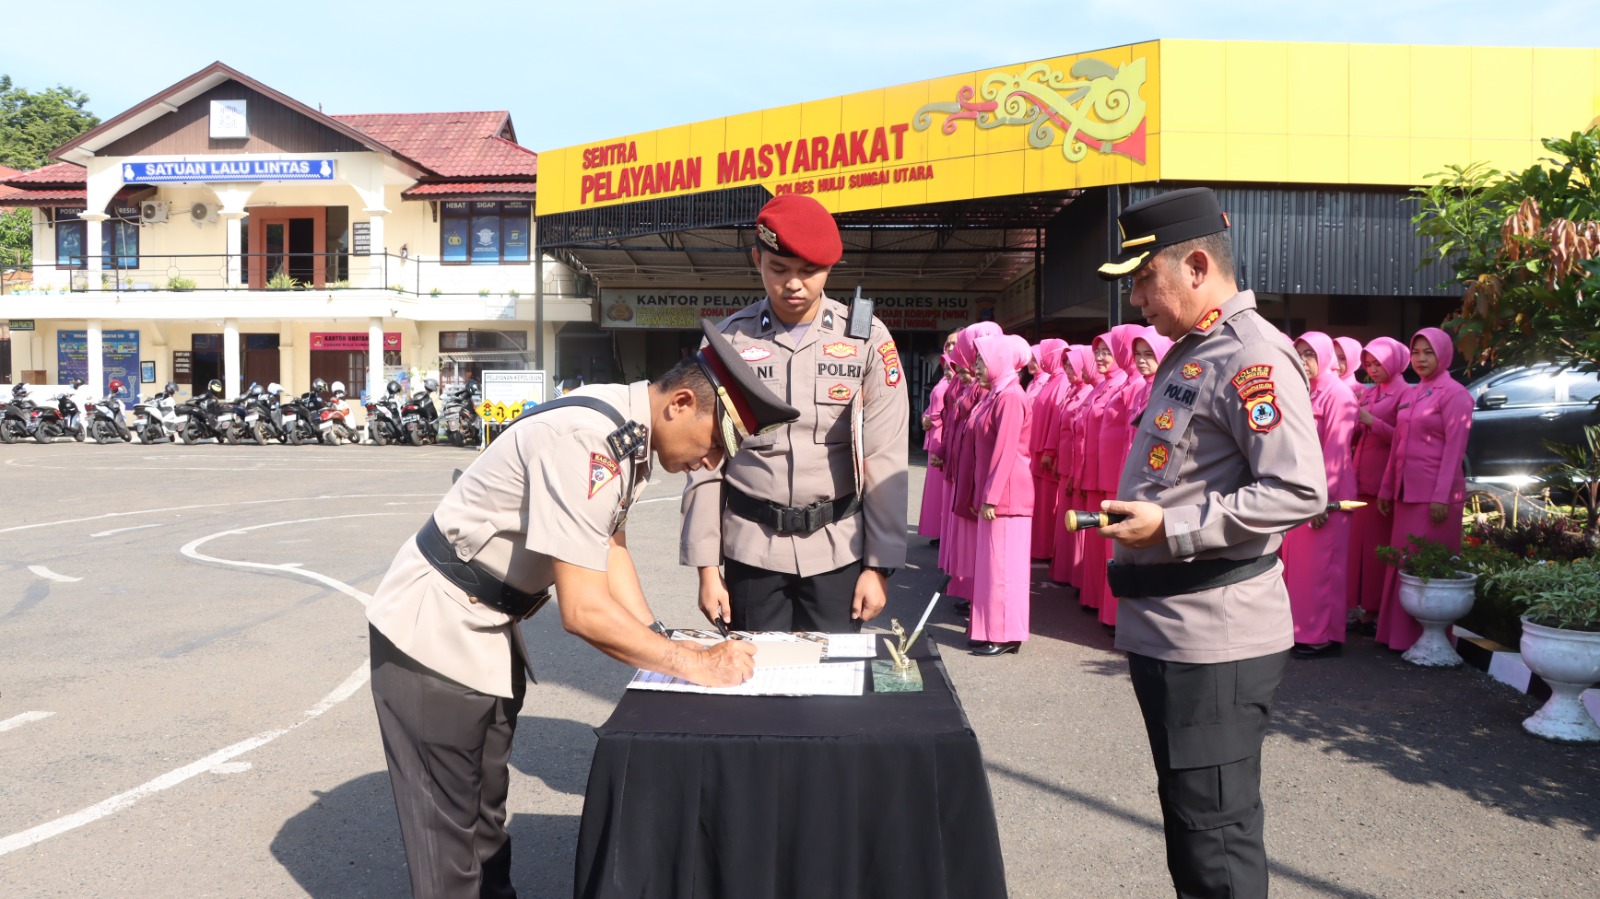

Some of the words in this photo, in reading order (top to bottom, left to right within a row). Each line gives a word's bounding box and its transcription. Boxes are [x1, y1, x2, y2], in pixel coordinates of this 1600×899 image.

[580, 156, 702, 204] PELAYANAN
[717, 123, 909, 184] MASYARAKAT
[582, 141, 638, 170] SENTRA
[145, 162, 207, 175] SATUAN
[210, 161, 250, 174] LALU
[255, 160, 310, 174] LINTAS
[775, 179, 814, 198] POLRES
[817, 176, 845, 193] HULU
[849, 170, 889, 189] SUNGAI
[894, 164, 934, 182] UTARA
[637, 295, 698, 306] KANTOR
[875, 297, 933, 308] POLRES
[938, 297, 968, 308] HSU
[637, 315, 695, 326] KAWASAN
[700, 308, 724, 317] ZONA
[882, 309, 902, 318] DARI
[904, 309, 940, 318] KORUPSI
[817, 362, 862, 378] POLRI
[1235, 366, 1269, 382] POLRES
[1164, 383, 1197, 405] POLRI
